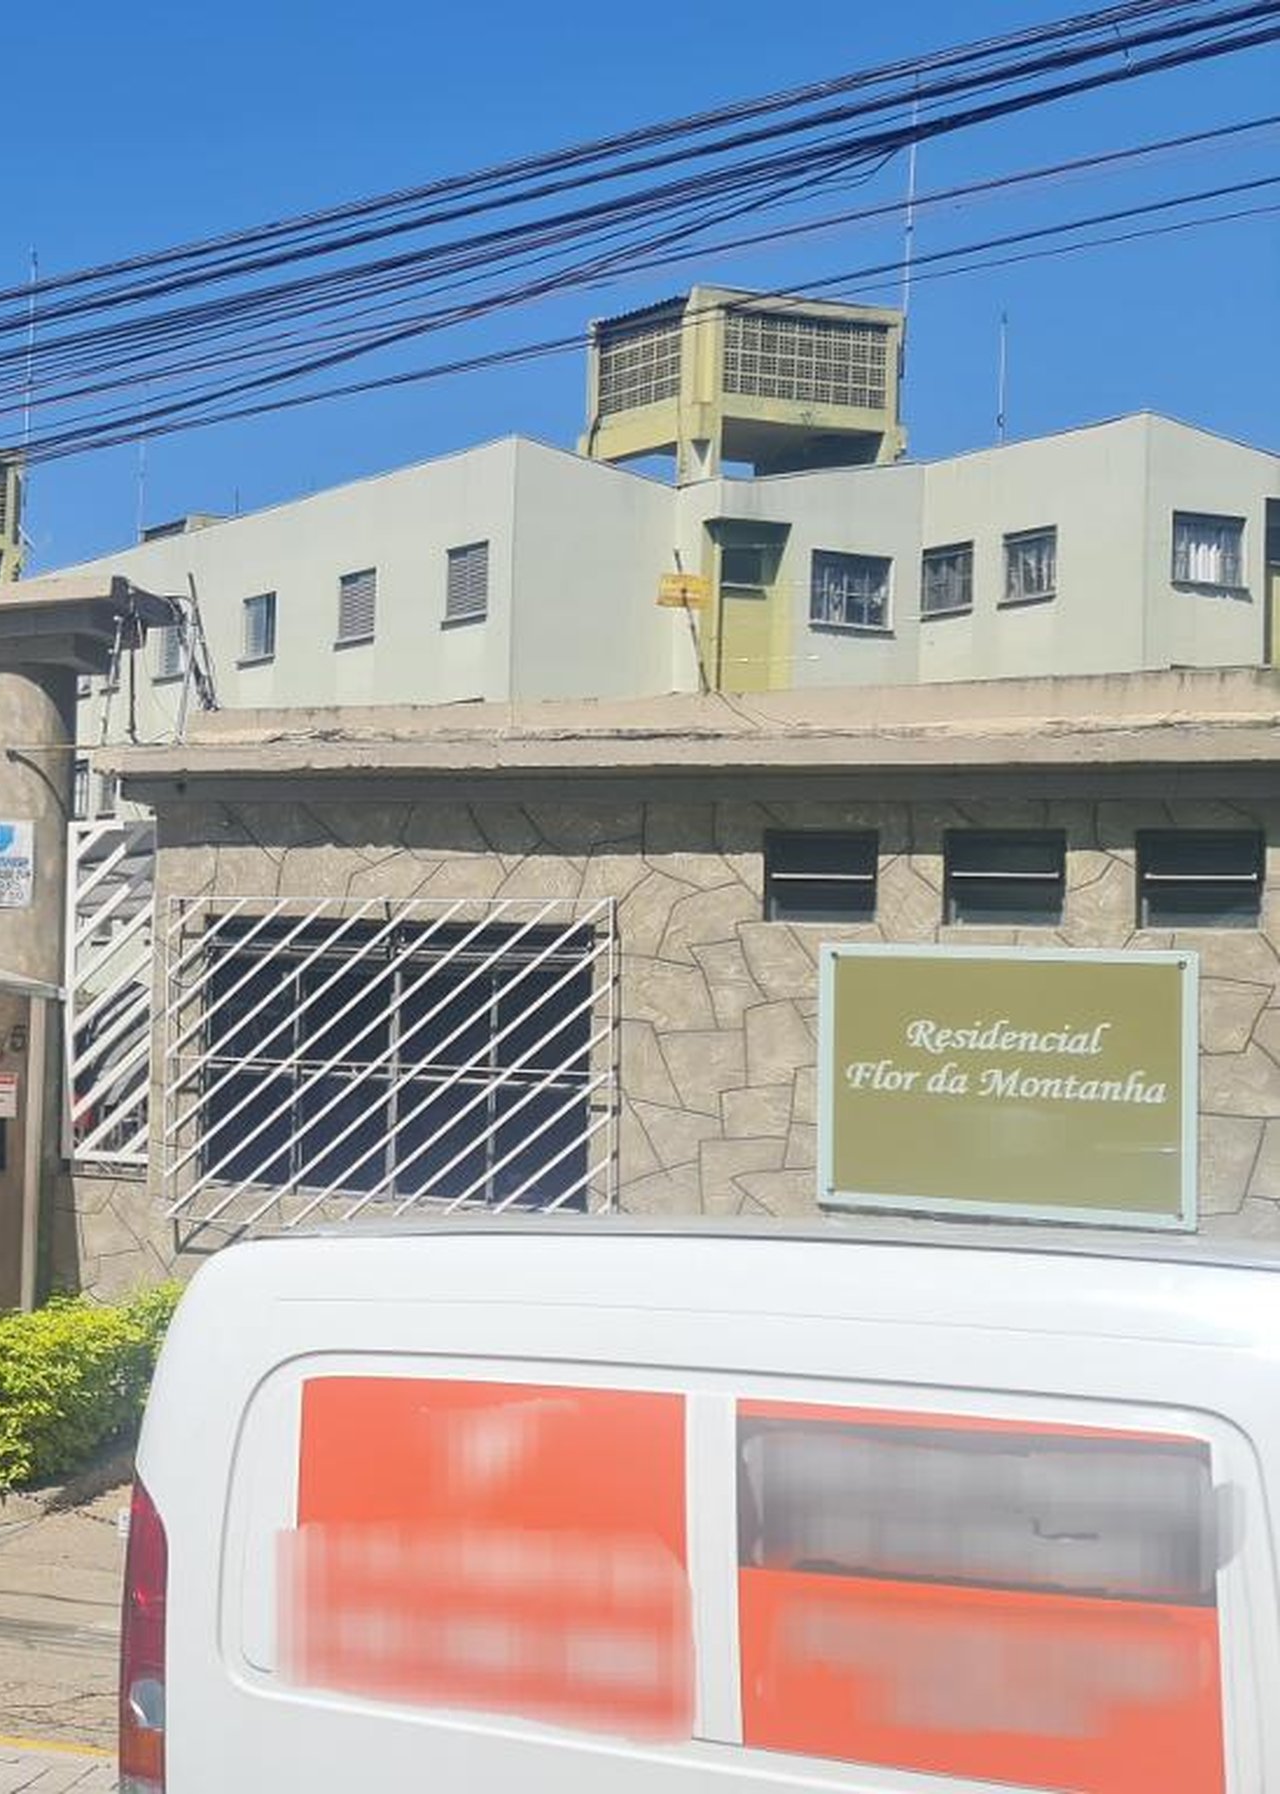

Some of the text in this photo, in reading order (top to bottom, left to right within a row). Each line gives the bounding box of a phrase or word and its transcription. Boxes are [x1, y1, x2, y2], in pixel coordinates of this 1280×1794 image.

[907, 1021, 1111, 1054] Residencial
[846, 1060, 1167, 1104] Flor da Montanha
